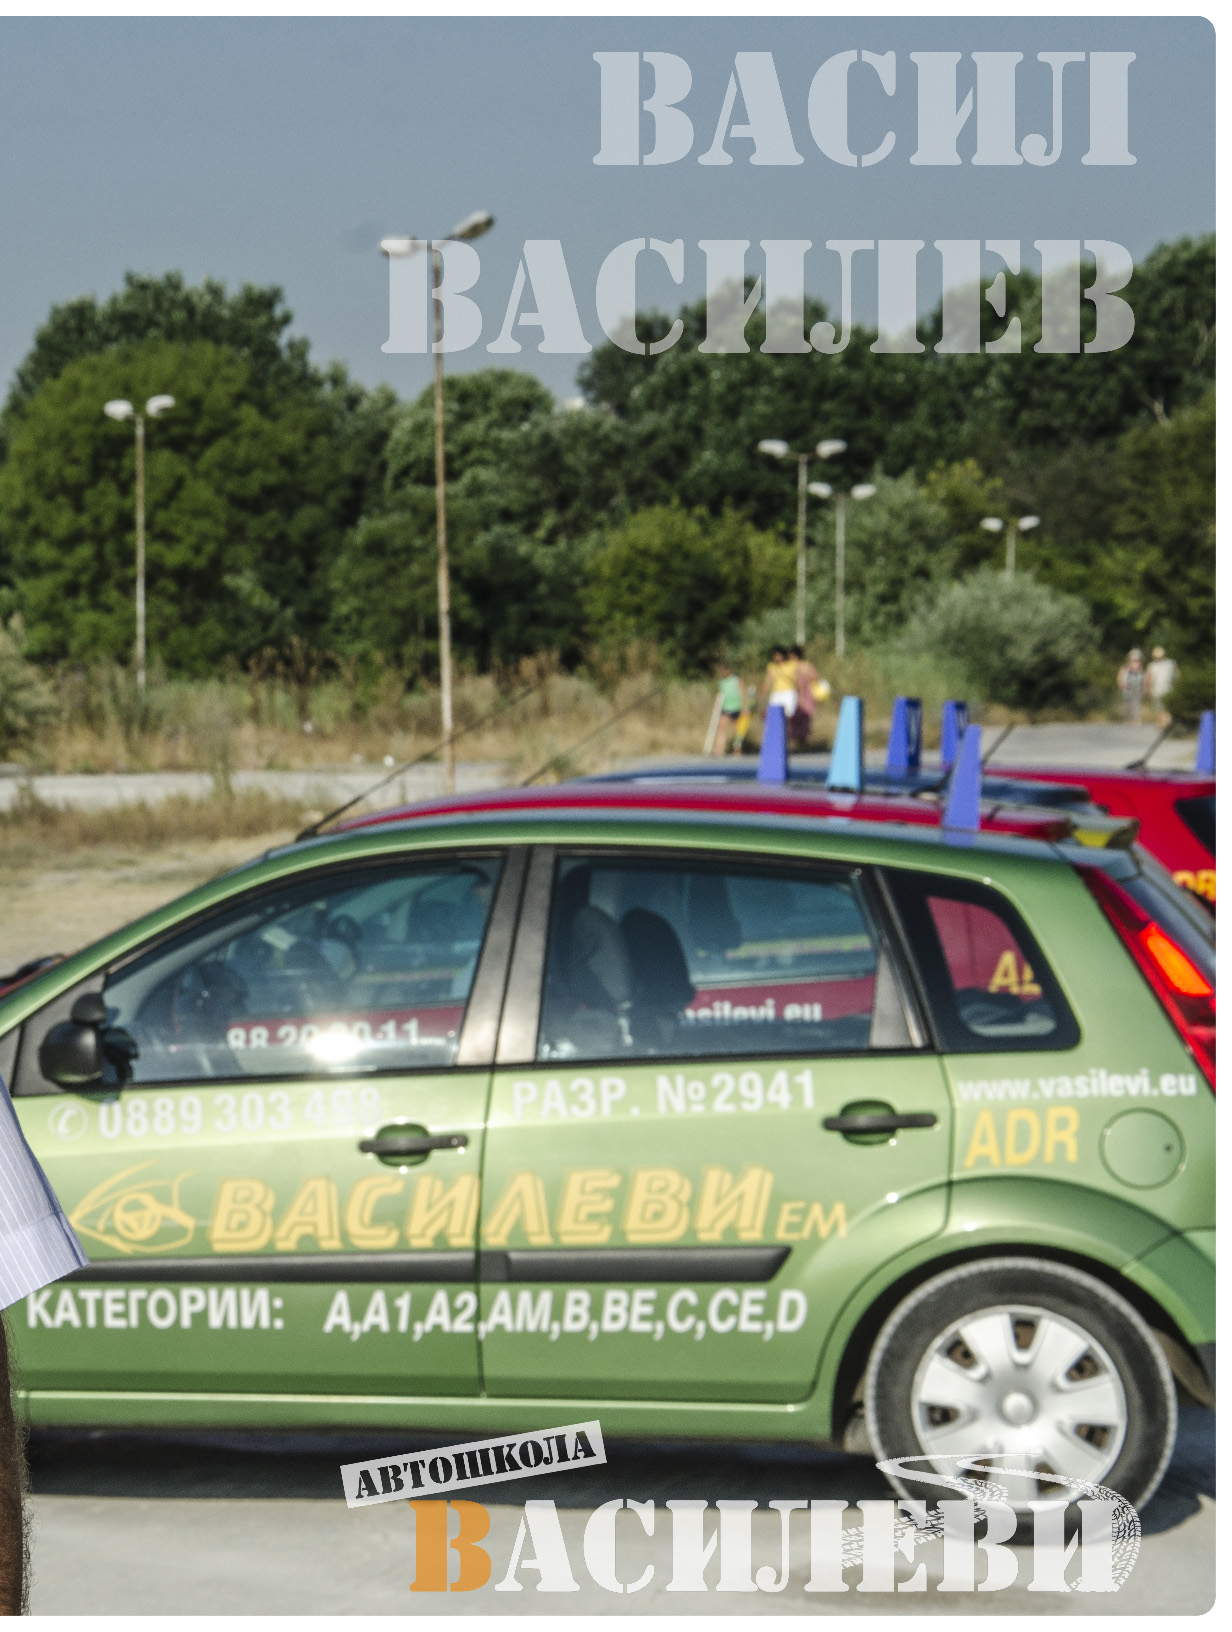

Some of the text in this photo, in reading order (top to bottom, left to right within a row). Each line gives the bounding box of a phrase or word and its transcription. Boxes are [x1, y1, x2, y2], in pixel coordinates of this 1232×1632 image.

[512, 1076, 641, 1119] РАЗР.
[957, 1066, 1198, 1102] www.vasilevi.eu
[98, 1095, 203, 1139] 0889
[216, 1091, 292, 1133] 303
[964, 1105, 1081, 1169] ADR
[208, 1163, 775, 1252] ВАСИЛЕВИ
[27, 1287, 285, 1330] КАТЕГОРИИ:
